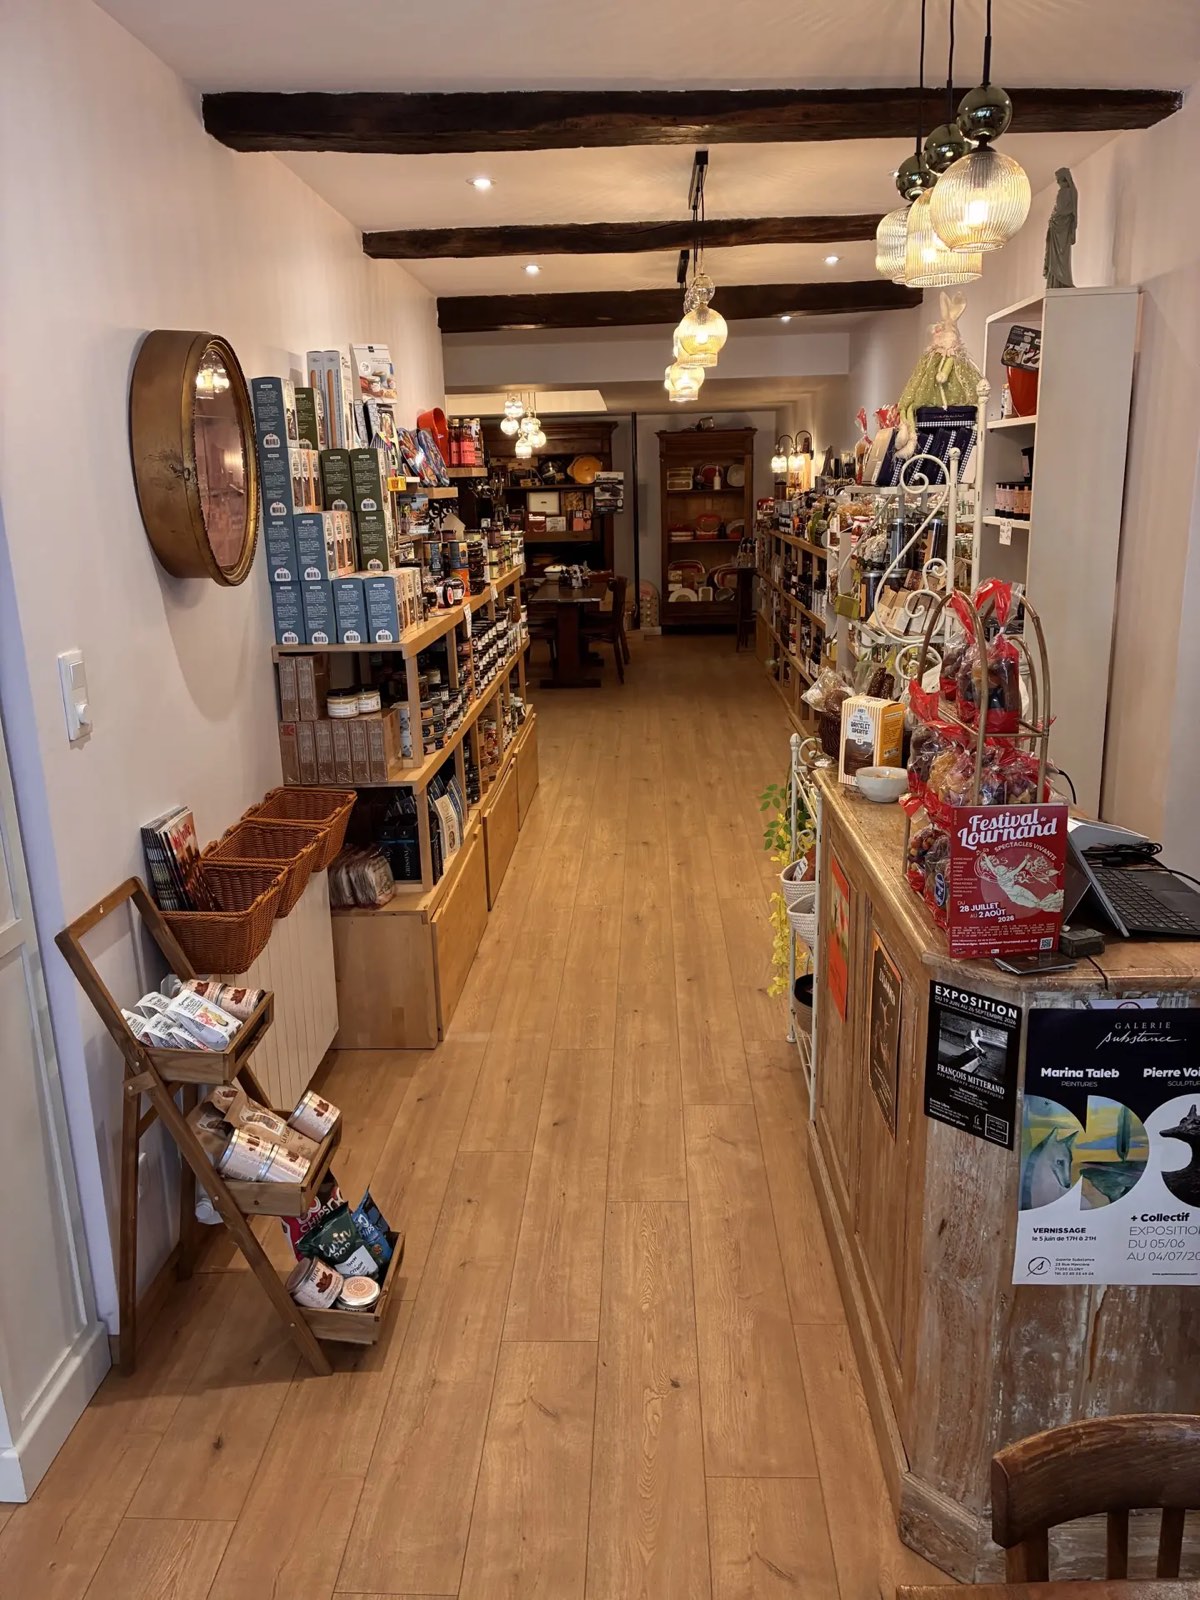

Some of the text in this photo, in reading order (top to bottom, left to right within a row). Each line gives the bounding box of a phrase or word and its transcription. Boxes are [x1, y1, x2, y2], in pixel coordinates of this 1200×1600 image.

[968, 808, 1038, 832] Festival
[958, 818, 1058, 850] Lournand
[994, 841, 1057, 861] SPECTACLES VIVANTS
[971, 902, 999, 911] JUILLET
[984, 908, 1006, 917] AOÛT
[998, 915, 1015, 923] 2026
[935, 985, 1018, 1019] EXPOSITION
[975, 1008, 1003, 1021] SEPTEMBRE
[937, 1063, 967, 1081] FRANÇOIS
[1040, 1067, 1120, 1078] Marina Taleb
[1143, 1067, 1181, 1078] Pierre
[1141, 1212, 1190, 1222] Collectif
[1128, 1239, 1186, 1249] DU 05/06
[1127, 1252, 1146, 1261] AU
